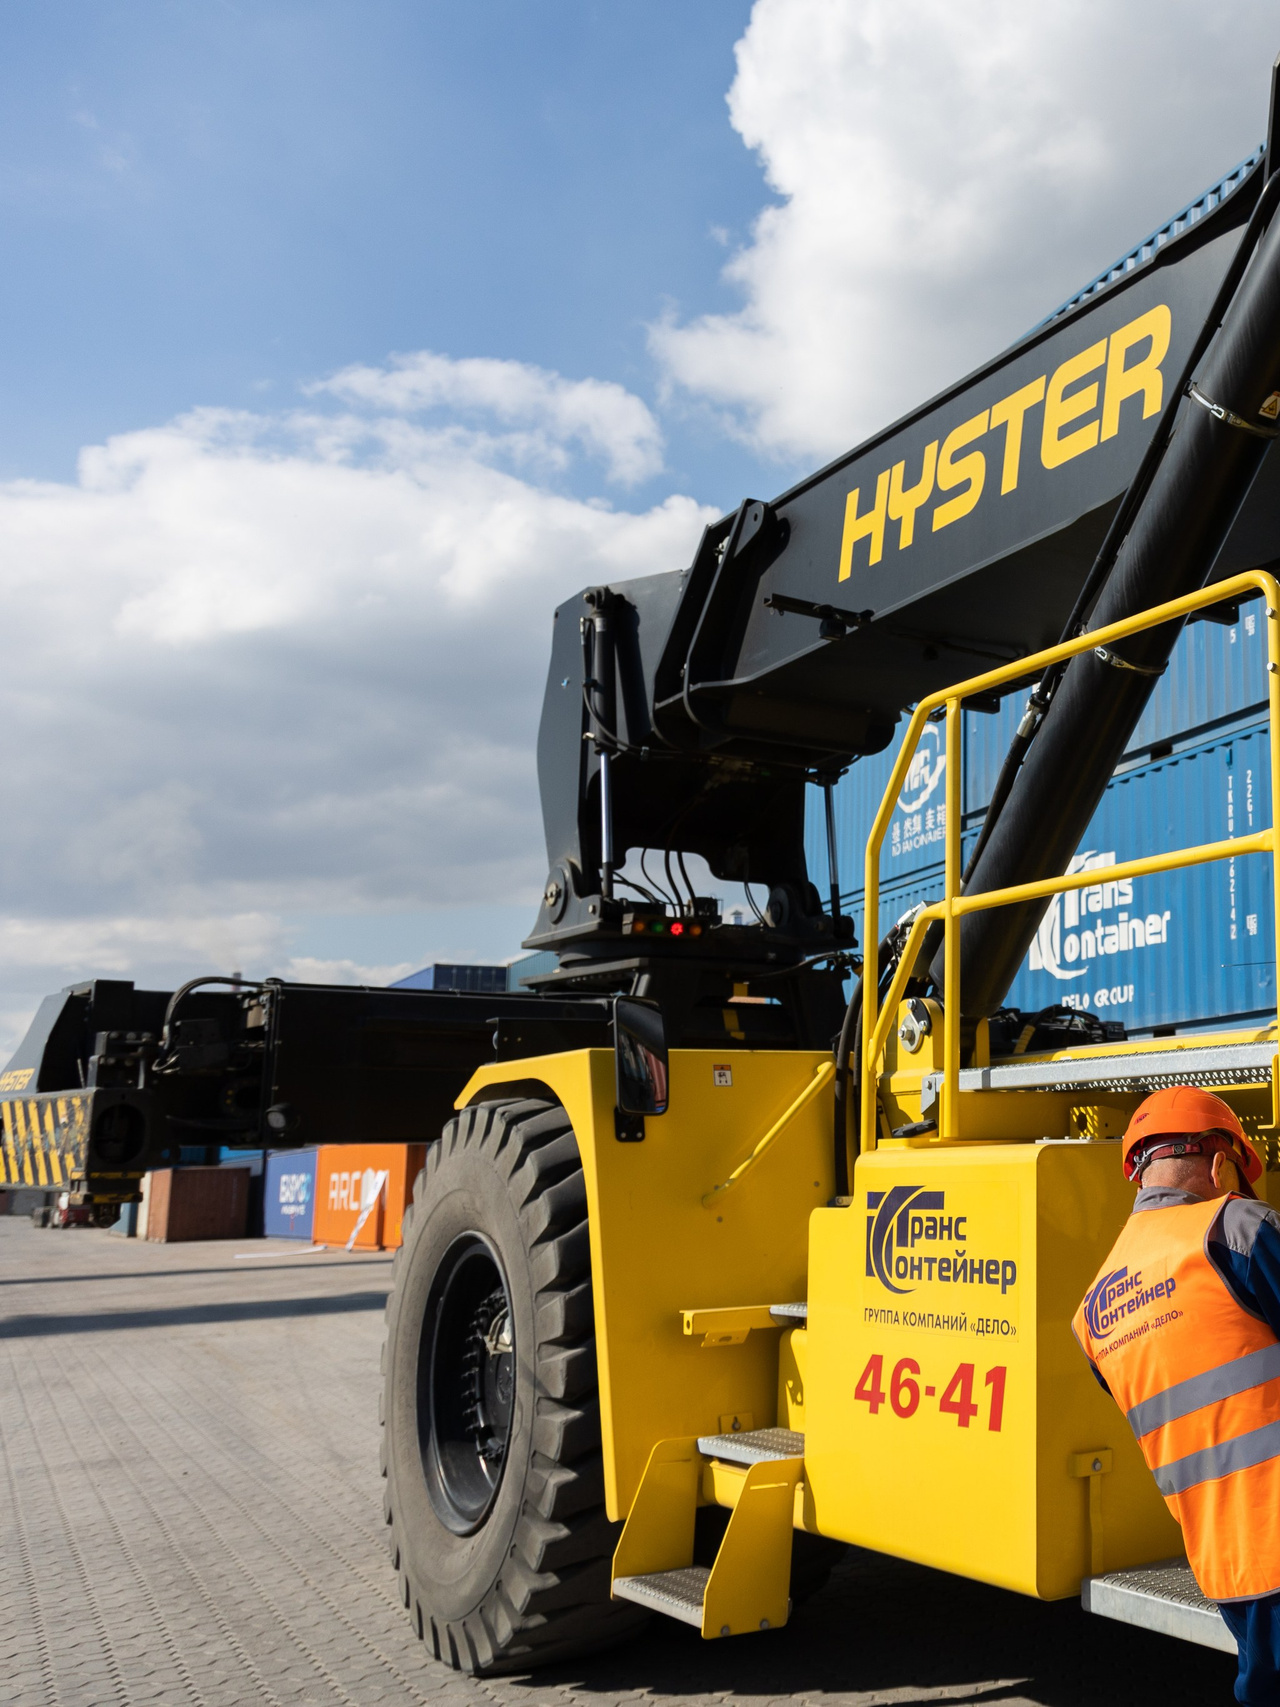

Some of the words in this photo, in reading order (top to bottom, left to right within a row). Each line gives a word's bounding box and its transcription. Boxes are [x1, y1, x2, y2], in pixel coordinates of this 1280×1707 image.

[838, 304, 1172, 583] HYSTER
[867, 1186, 967, 1248] Транс
[864, 1307, 900, 1326] ГРУППА
[902, 1311, 968, 1332] КОМПАНИЙ
[970, 1317, 1017, 1337] «ДЕЛО»
[1108, 1321, 1150, 1353] КОМПАНИЙ
[854, 1354, 1008, 1432] 46-41
